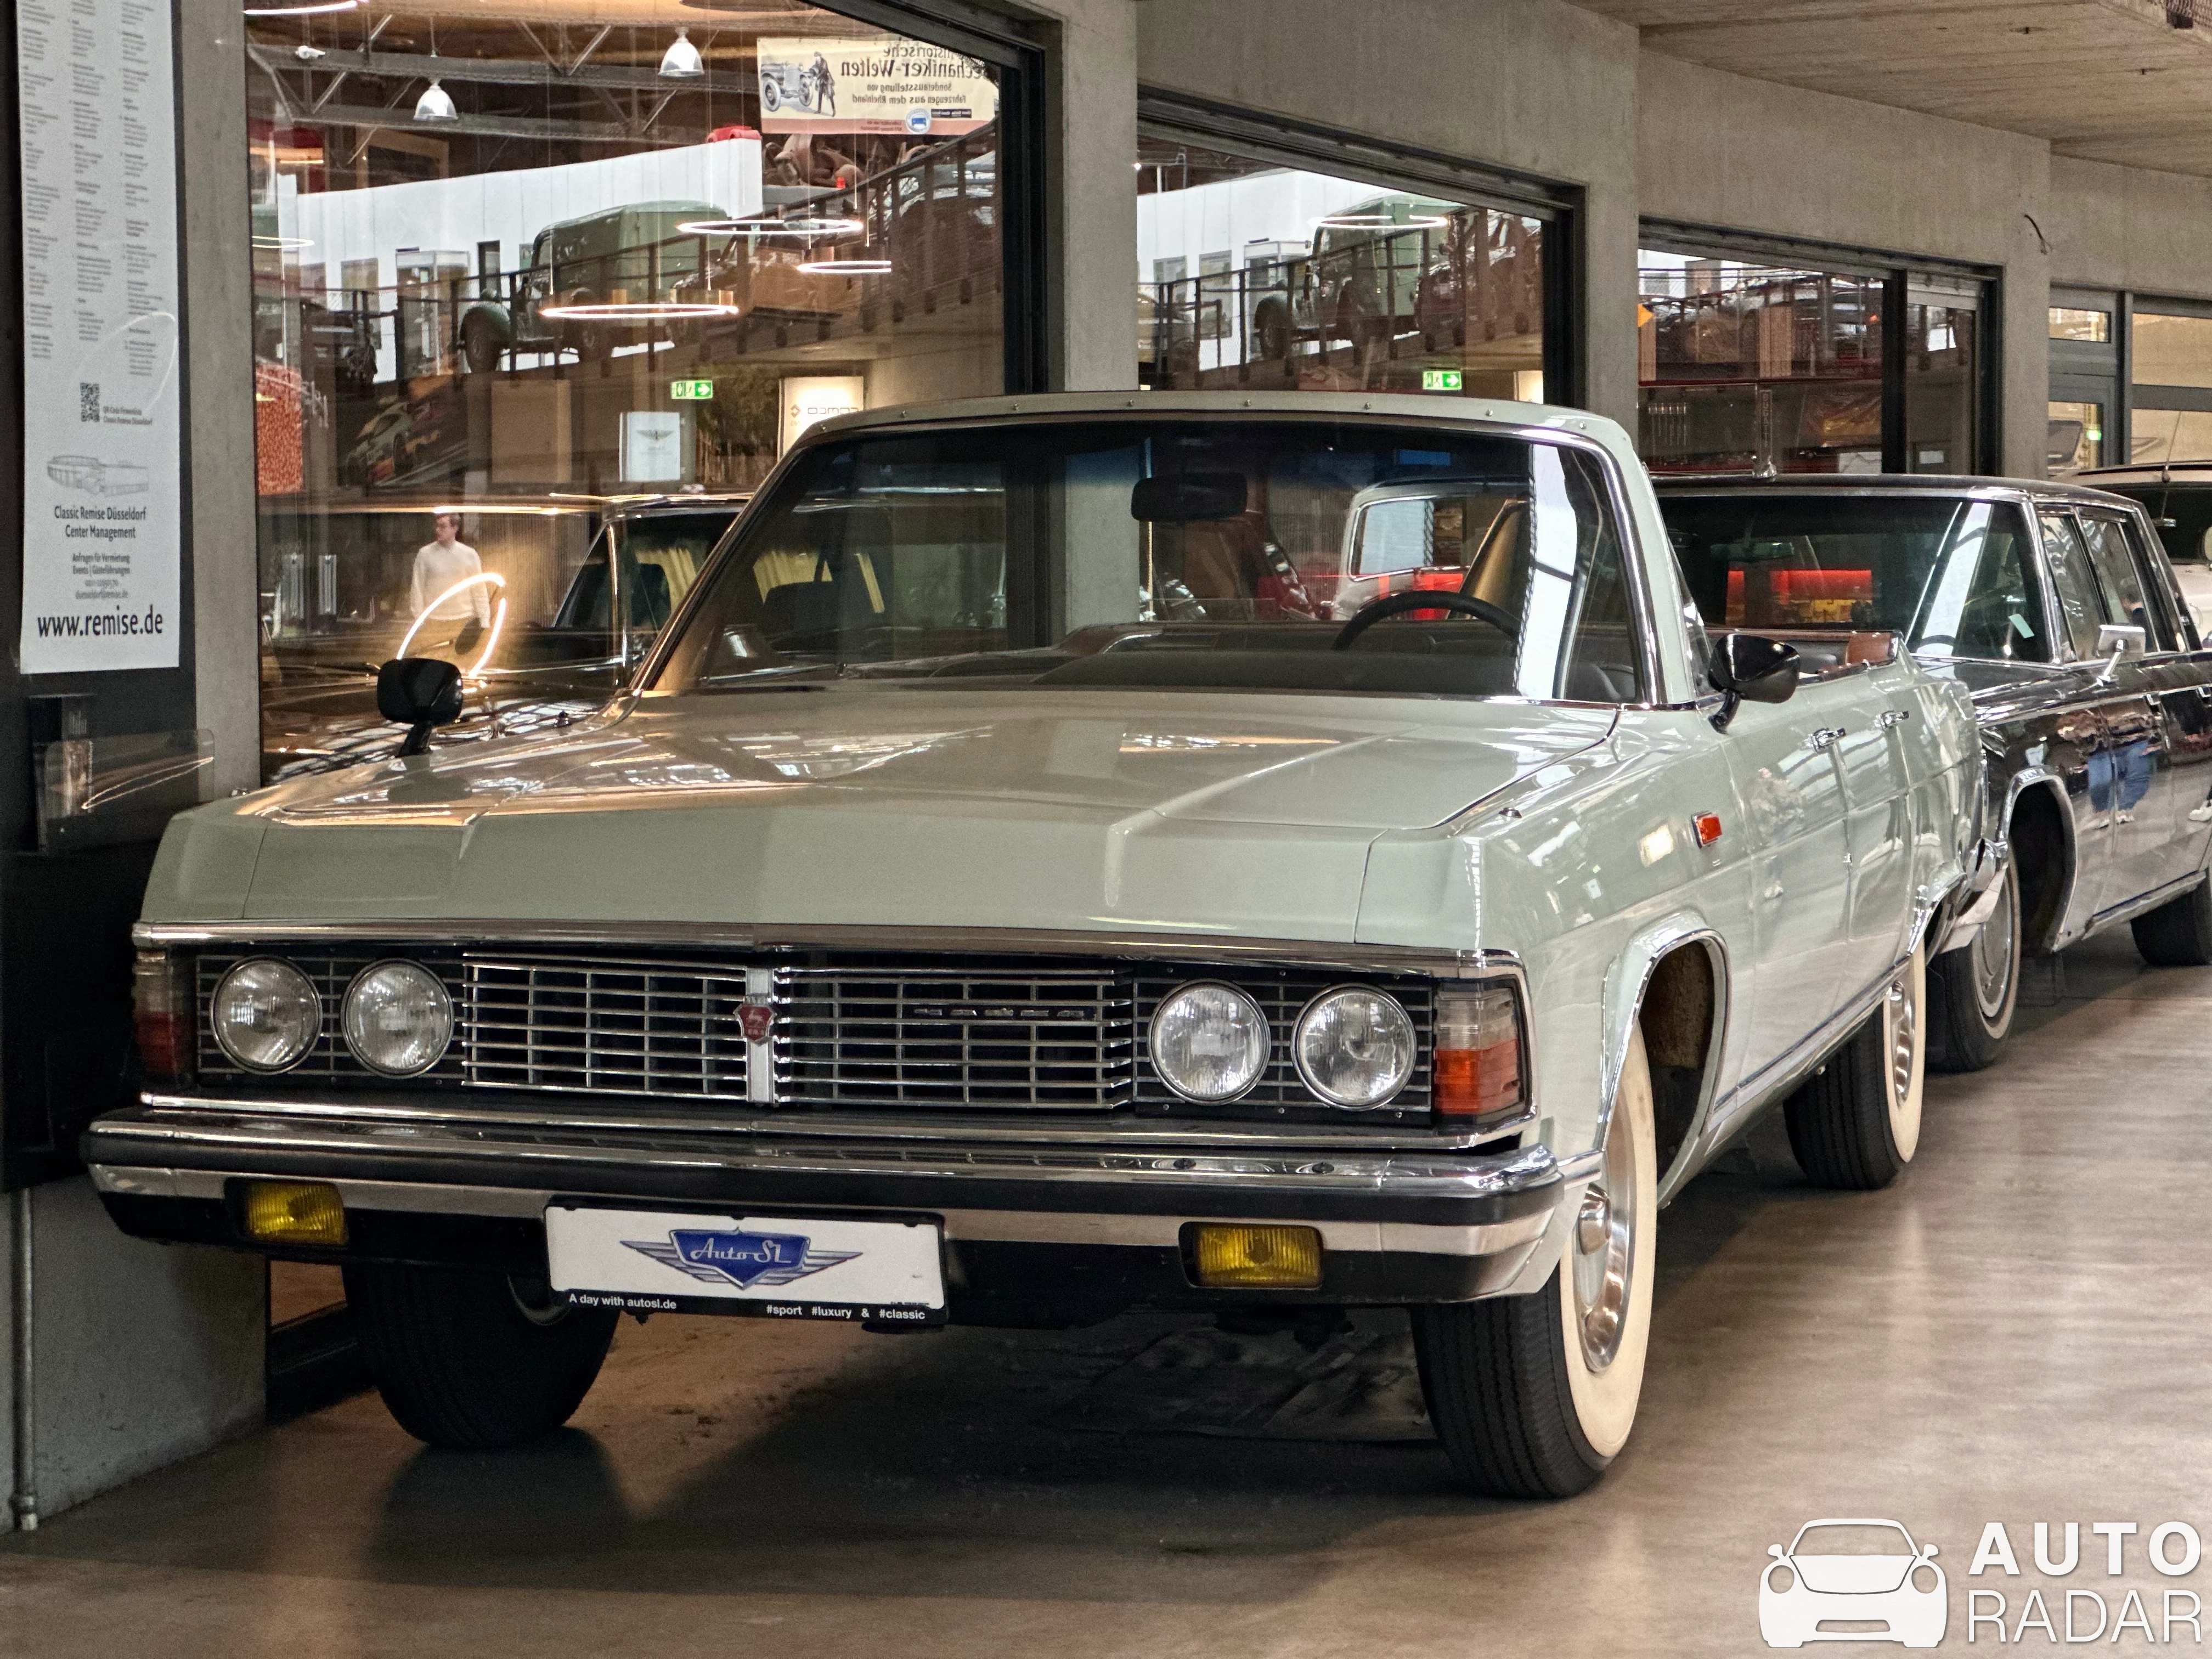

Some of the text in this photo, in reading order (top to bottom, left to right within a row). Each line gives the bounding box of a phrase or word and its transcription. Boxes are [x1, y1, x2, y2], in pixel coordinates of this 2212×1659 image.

[54, 505, 147, 520] Classic Remise Düsseldorf
[65, 524, 136, 542] Center Management
[37, 604, 163, 637] www.remise.de
[569, 1293, 677, 1310] A day with autosl.de
[766, 1304, 926, 1320] #sport #luxury & #classic
